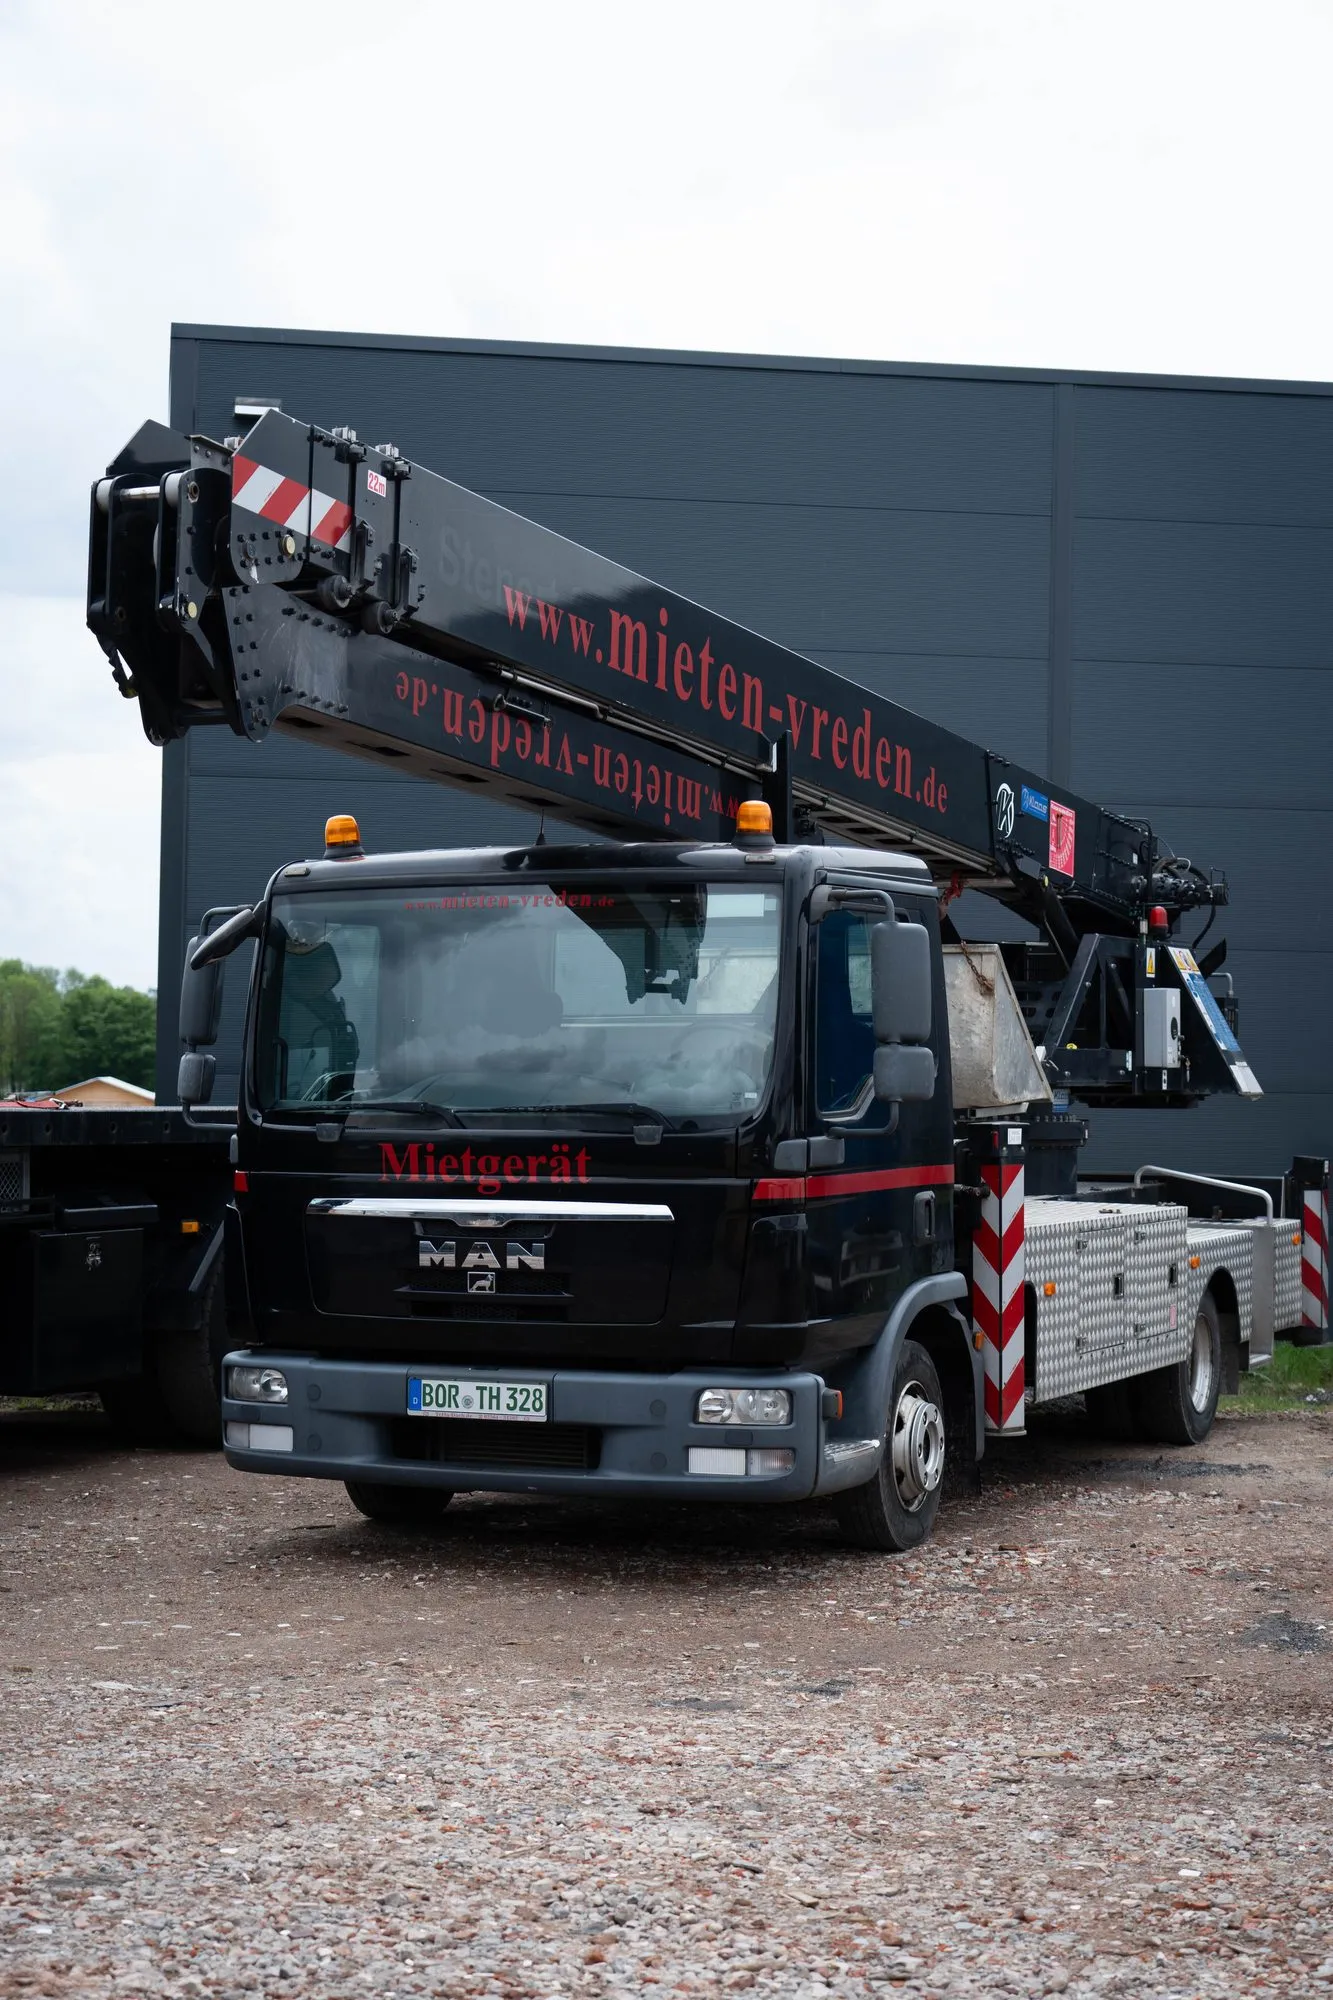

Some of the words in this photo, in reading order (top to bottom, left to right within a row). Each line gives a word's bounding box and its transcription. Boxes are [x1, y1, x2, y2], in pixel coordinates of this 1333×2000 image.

[368, 472, 386, 496] 22m
[503, 585, 948, 813] www.mieten-vreden.de
[395, 671, 739, 826] ww.mieten-vreden.de
[404, 889, 615, 911] www.mieten-vreden.de
[378, 1142, 592, 1195] Mietgerät
[419, 1240, 545, 1270] MAN
[422, 1383, 459, 1409] BOR
[476, 1386, 501, 1411] TH
[506, 1387, 544, 1413] 328
